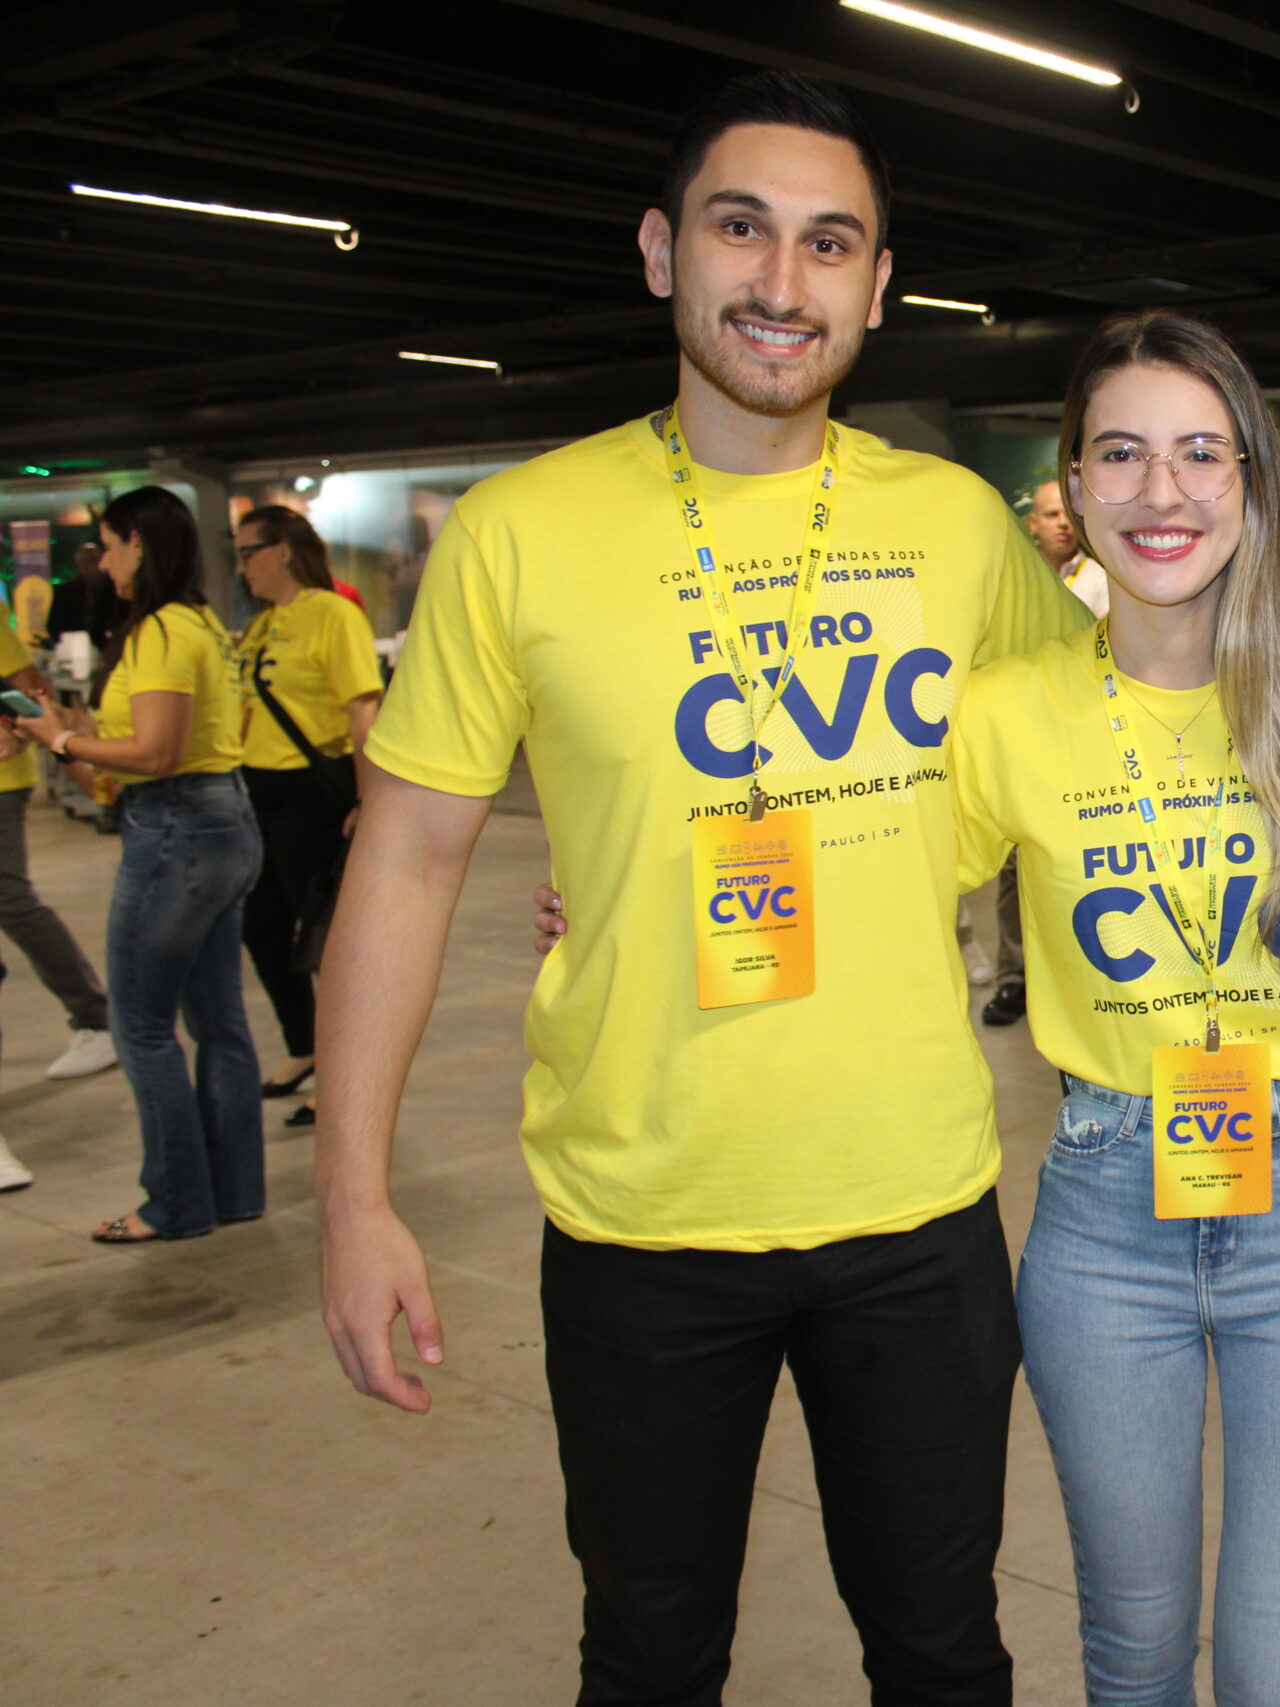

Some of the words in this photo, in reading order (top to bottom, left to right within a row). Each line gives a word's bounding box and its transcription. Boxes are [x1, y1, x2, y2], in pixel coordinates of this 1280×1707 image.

[685, 497, 703, 529] CVC
[812, 502, 827, 532] CVC
[660, 559, 772, 584] CONNÇÃO
[782, 555, 802, 567] DE
[827, 550, 881, 562] ENDAS
[889, 550, 926, 560] 2025
[732, 578, 766, 594] AOS
[769, 569, 850, 588] PRÓMOS
[853, 569, 872, 580] 50
[875, 567, 916, 579] ANOS
[675, 647, 953, 779] CVC
[1125, 748, 1142, 780] CVC
[686, 801, 749, 822] JUNTO
[765, 786, 836, 811] ONTEM,
[839, 778, 885, 798] HOJE
[889, 776, 900, 790] E
[1063, 781, 1166, 803] CONVENO
[1177, 778, 1197, 789] DE
[1078, 802, 1124, 821] RUMO
[1162, 792, 1240, 810] PRÓXIMS
[821, 834, 865, 848] PAULO
[883, 827, 901, 837] SP
[716, 874, 771, 889] FUTURO
[708, 885, 798, 924] CVC
[755, 953, 776, 962] SILVA
[1094, 999, 1149, 1015] JUNTOS
[1216, 989, 1260, 1002] HOJE
[1264, 988, 1274, 1000] E
[1261, 1026, 1277, 1034] SP
[1174, 1100, 1228, 1113] FUTURO
[1166, 1112, 1254, 1144] CVC
